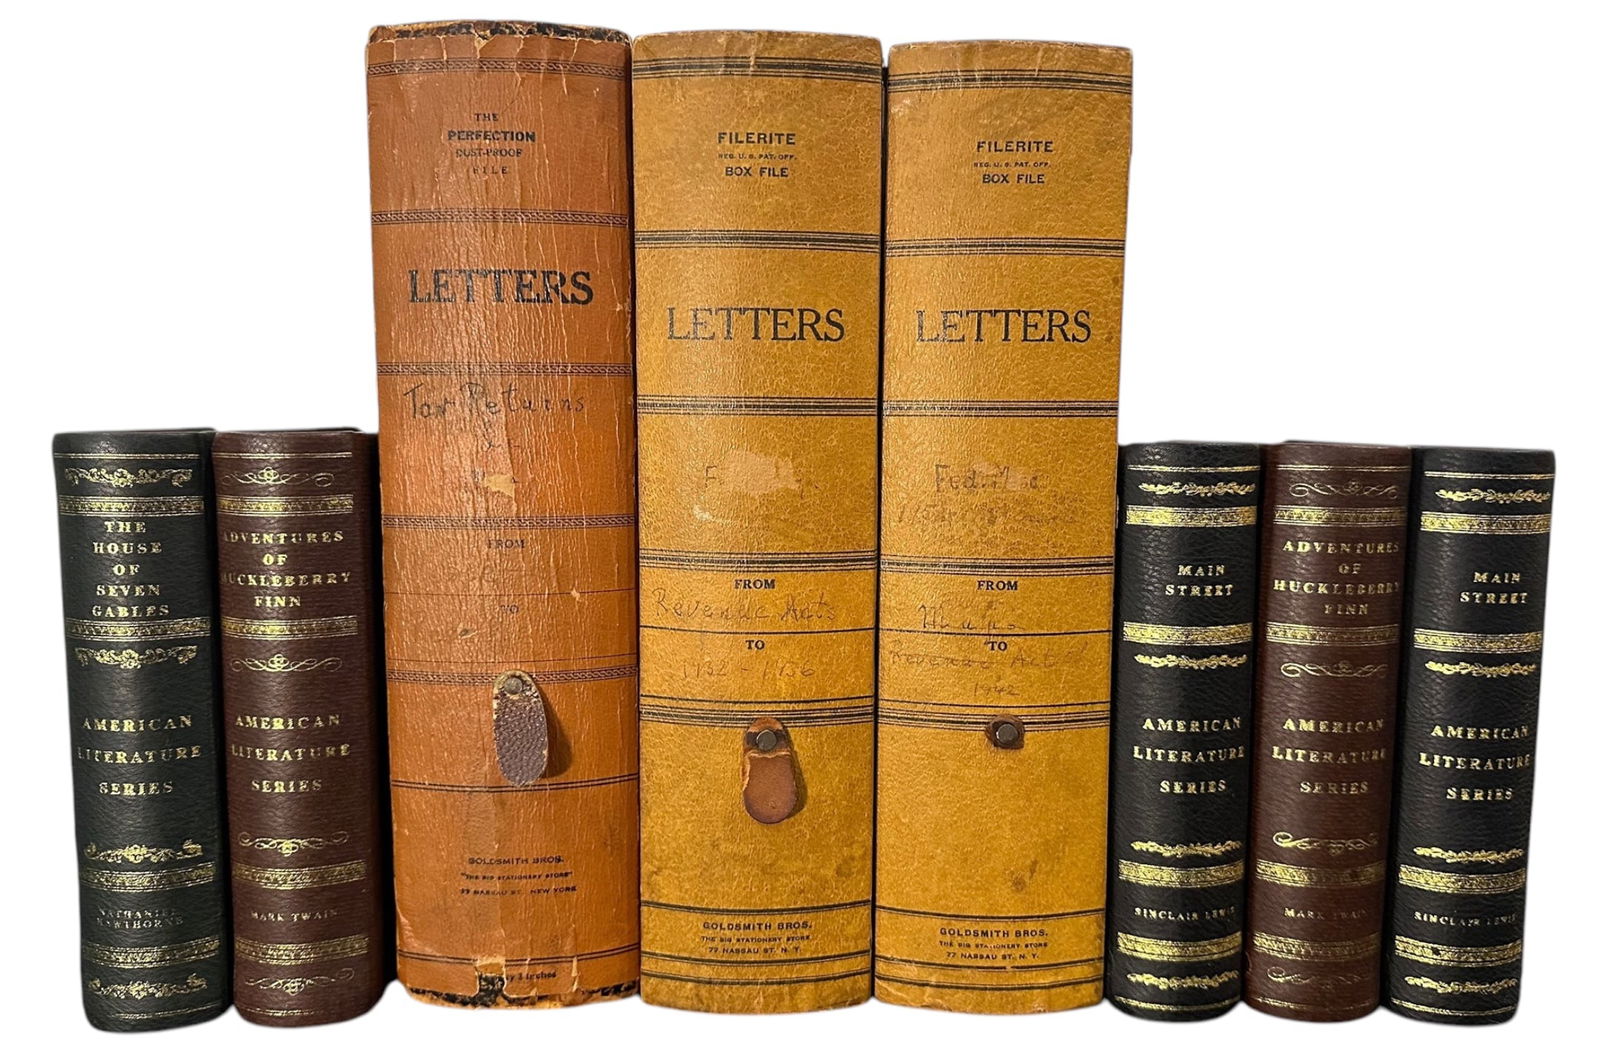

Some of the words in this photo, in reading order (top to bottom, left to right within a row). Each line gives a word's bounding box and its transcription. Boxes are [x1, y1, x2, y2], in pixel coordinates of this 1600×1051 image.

[474, 113, 499, 122] THE
[448, 130, 535, 142] PERFECTION
[718, 132, 796, 145] FILERITE
[977, 141, 1053, 152] FILERITE
[456, 149, 523, 157] DUST-PROOF
[472, 166, 509, 175] FILE
[725, 167, 752, 176] BOX
[760, 167, 788, 177] FILE
[983, 174, 1009, 183] BOX
[1017, 174, 1045, 183] FILE
[408, 269, 594, 305] LETTERS
[667, 307, 845, 342] LETTERS
[916, 309, 1091, 343] LETTERS
[104, 521, 146, 533] THE
[222, 531, 344, 544] ADVENTURES
[93, 542, 162, 554] HOUSE
[487, 540, 525, 549] FROM
[1282, 541, 1398, 553] ADVENTURES
[262, 554, 287, 566] OF
[113, 564, 140, 576] OF
[1177, 565, 1224, 575] MAIN
[1338, 564, 1361, 574] OF
[1473, 572, 1520, 583] MAIN
[735, 579, 775, 589] FROM
[977, 581, 1018, 590] FROM
[1165, 584, 1233, 596] STREET
[96, 585, 160, 597] SEVEN
[254, 596, 301, 607] FINN
[1460, 592, 1528, 603] STREET
[92, 605, 170, 617] GABLES
[1325, 605, 1368, 614] FINN
[746, 640, 765, 650] TO
[989, 641, 1007, 651] TO
[82, 715, 192, 733] AMERICAN
[235, 714, 340, 730] AMERICAN
[1142, 717, 1241, 732] AMERICAN
[1283, 718, 1384, 733] AMERICAN
[1431, 725, 1529, 739] AMERICAN
[78, 745, 201, 763] LITERATURE
[231, 744, 350, 761] LITERATURE
[1133, 746, 1245, 763] LITERATURE
[1272, 746, 1385, 764] LITERATURE
[1419, 753, 1530, 770] LITERATURE
[98, 781, 173, 796] SERIES
[251, 780, 322, 793] SERIES
[1160, 780, 1226, 794] SERIES
[1299, 781, 1368, 794] SERIES
[1446, 788, 1513, 800] SERIES
[252, 911, 284, 921] MARK
[1135, 907, 1198, 921] SINCLAIR
[703, 922, 772, 931] GOLDSMITH
[778, 921, 812, 929] BROS.
[940, 928, 1009, 937] GOLDSMITH
[1015, 929, 1048, 937] BROS.
